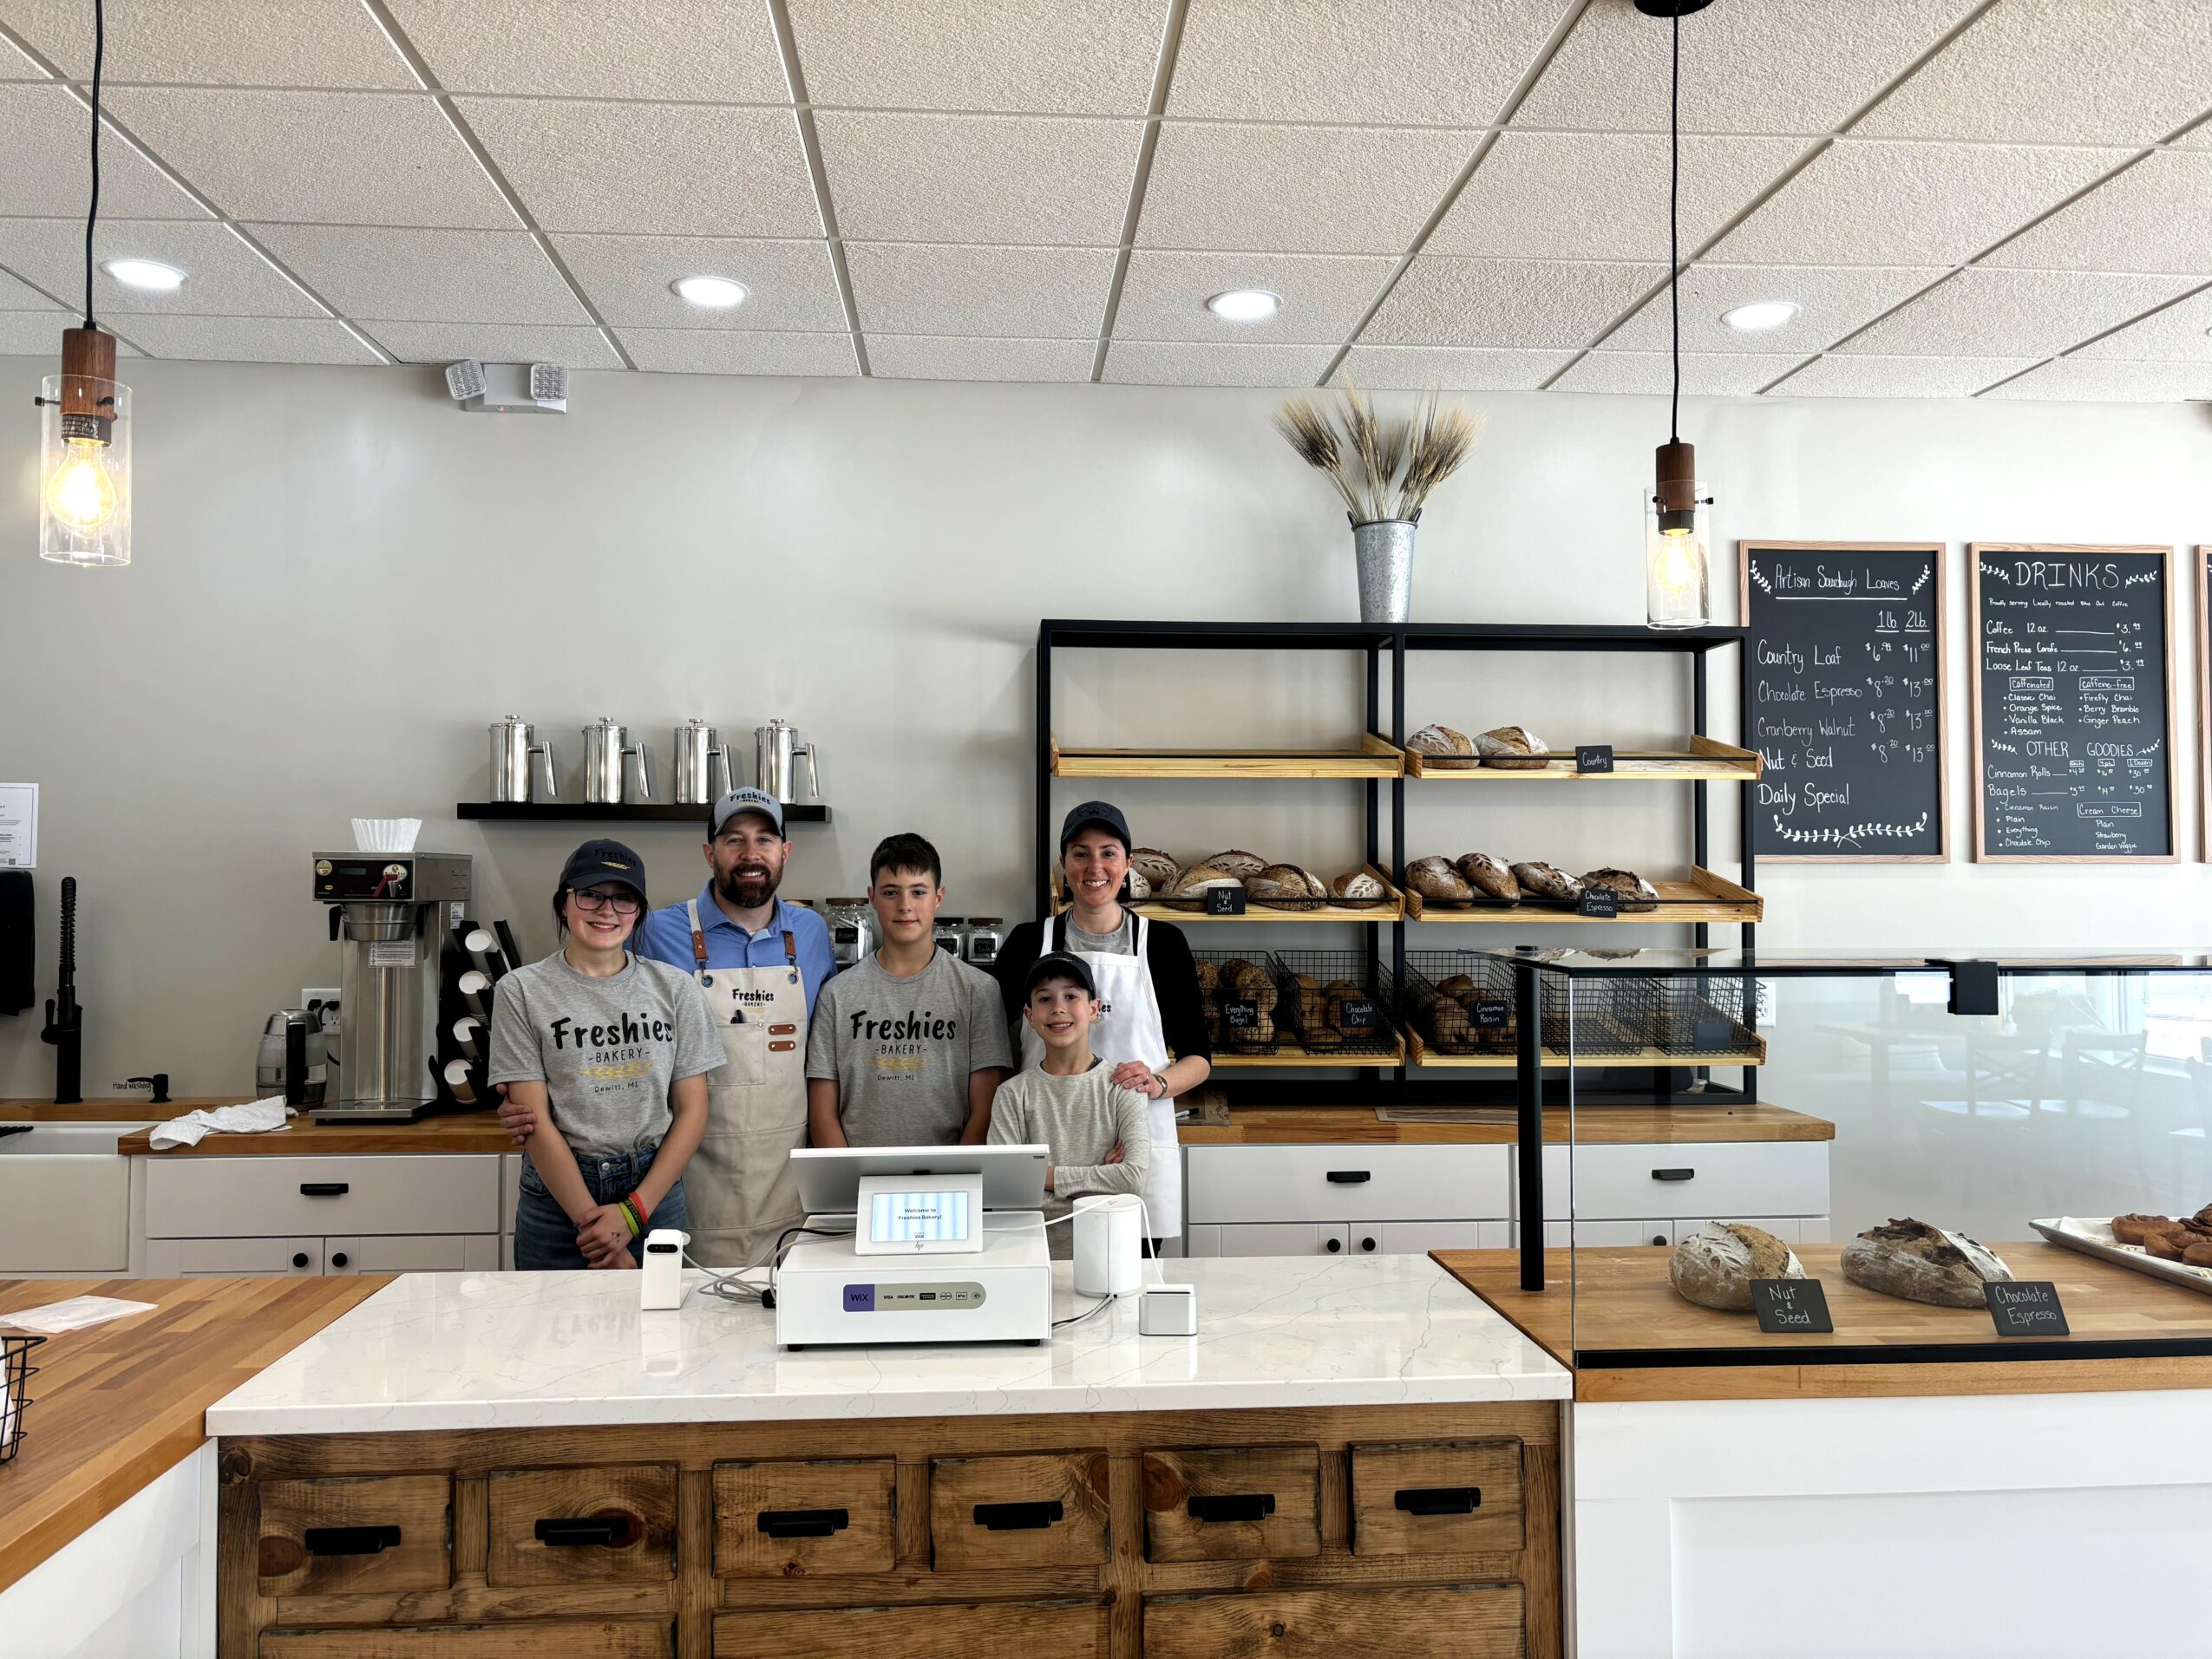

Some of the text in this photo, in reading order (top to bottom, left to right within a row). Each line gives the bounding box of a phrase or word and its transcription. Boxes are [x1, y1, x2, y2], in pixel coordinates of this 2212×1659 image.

[1775, 564, 1810, 589] Artisan
[1866, 568, 1900, 591] Loaves
[2014, 561, 2119, 590] DRINKS
[2009, 600, 2028, 609] serving
[1986, 619, 2013, 635] Coffee
[2026, 623, 2036, 633] 12
[1986, 641, 2011, 654] French
[2013, 642, 2032, 653] Press
[2036, 642, 2058, 653] Carafe
[1757, 639, 1804, 674] Country
[1815, 644, 1842, 665] Loaf
[1986, 658, 2012, 671] Loose
[2015, 659, 2032, 671] Leaf
[2035, 661, 2052, 672] Teas
[2057, 661, 2067, 672] 12
[1814, 681, 1862, 706] Espresso
[2084, 695, 2109, 704] Firefly
[2009, 704, 2062, 714] Orange Spice
[2084, 705, 2106, 715] Berry
[2009, 715, 2065, 724] Vanilla Black
[2083, 717, 2110, 728] Ginger
[1757, 717, 1812, 747] Cranberry
[1818, 716, 1856, 736] Walnut
[2011, 727, 2042, 735] Assam
[2026, 741, 2134, 757] OTHER GOODIES
[1581, 753, 1607, 768] Country
[1760, 747, 1785, 771] Nut
[1791, 749, 1797, 767] &
[1806, 746, 1833, 768] Seed
[1987, 764, 2027, 779] Cinnamon
[2031, 765, 2051, 780] Rolls
[730, 792, 771, 805] Freshies
[1757, 782, 1849, 816] Daily Special
[1987, 784, 2027, 804] Bagels
[2079, 804, 2139, 815] Cream Cheese
[2006, 826, 2039, 839] Everything
[2096, 832, 2127, 844] Strawberry
[2035, 838, 2051, 848] Chip
[1218, 890, 1232, 900] Nut
[1585, 892, 1612, 901] Chocolate
[1216, 904, 1233, 912] Seed
[1586, 902, 1613, 913] Espresso
[732, 988, 775, 1002] Freshies
[1225, 1003, 1254, 1016] Everything
[1345, 1003, 1373, 1014] Chocolate
[1476, 1003, 1504, 1013] Cinnamon
[1229, 1015, 1248, 1025] Bagel
[1351, 1014, 1366, 1025] Chip
[1480, 1014, 1500, 1023] Raisin
[551, 1012, 673, 1049] Freshies
[850, 1010, 956, 1041] Freshies
[128, 1082, 151, 1092] washing
[1769, 1285, 1796, 1301] Nut
[1995, 1285, 2048, 1303] Chocolate
[1775, 1309, 1812, 1325] Seed
[2006, 1308, 2057, 1327] Espresso
